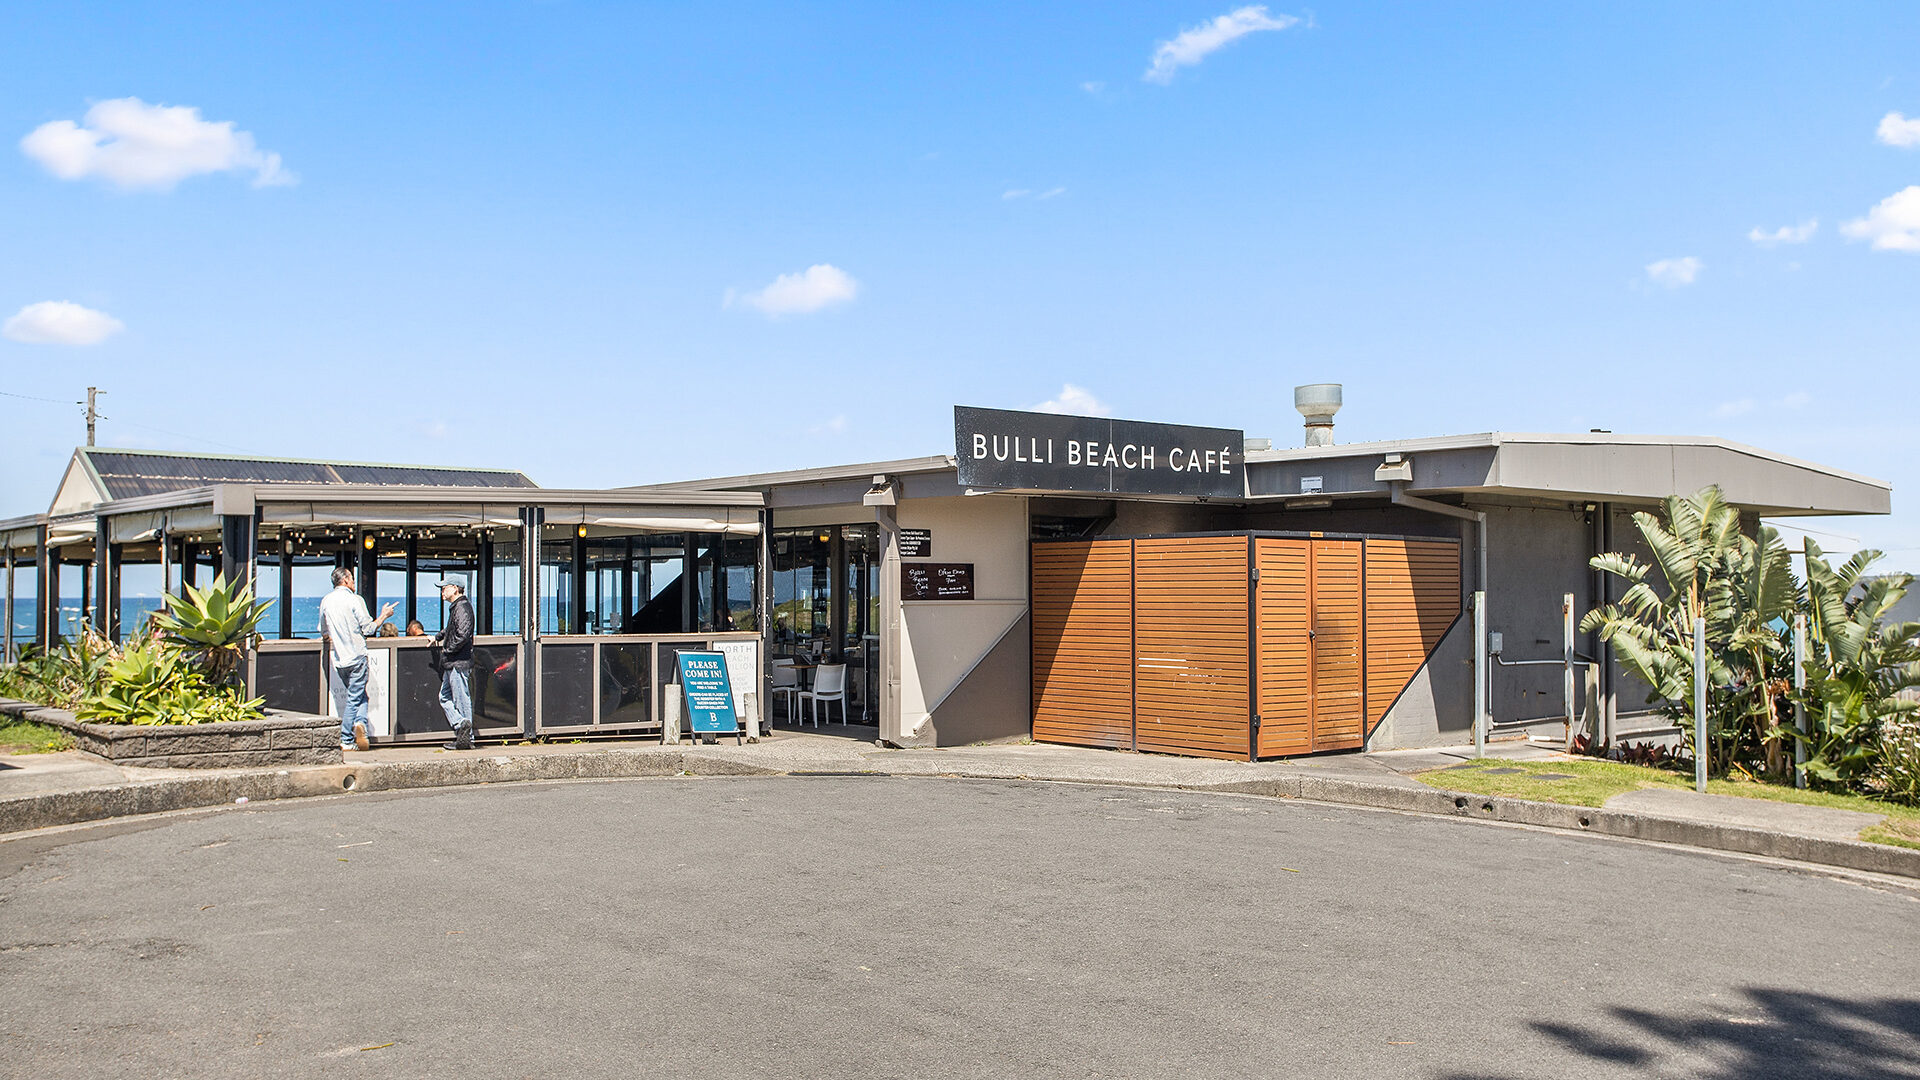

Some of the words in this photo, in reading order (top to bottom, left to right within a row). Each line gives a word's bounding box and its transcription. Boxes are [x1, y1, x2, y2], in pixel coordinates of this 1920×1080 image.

[972, 433, 1053, 464] BULLI
[1067, 440, 1156, 470] BEACH
[1168, 446, 1232, 475] CAFÉ
[688, 661, 718, 669] PLEASE
[685, 670, 709, 678] COME
[710, 670, 722, 678] IN!
[709, 712, 718, 722] B
